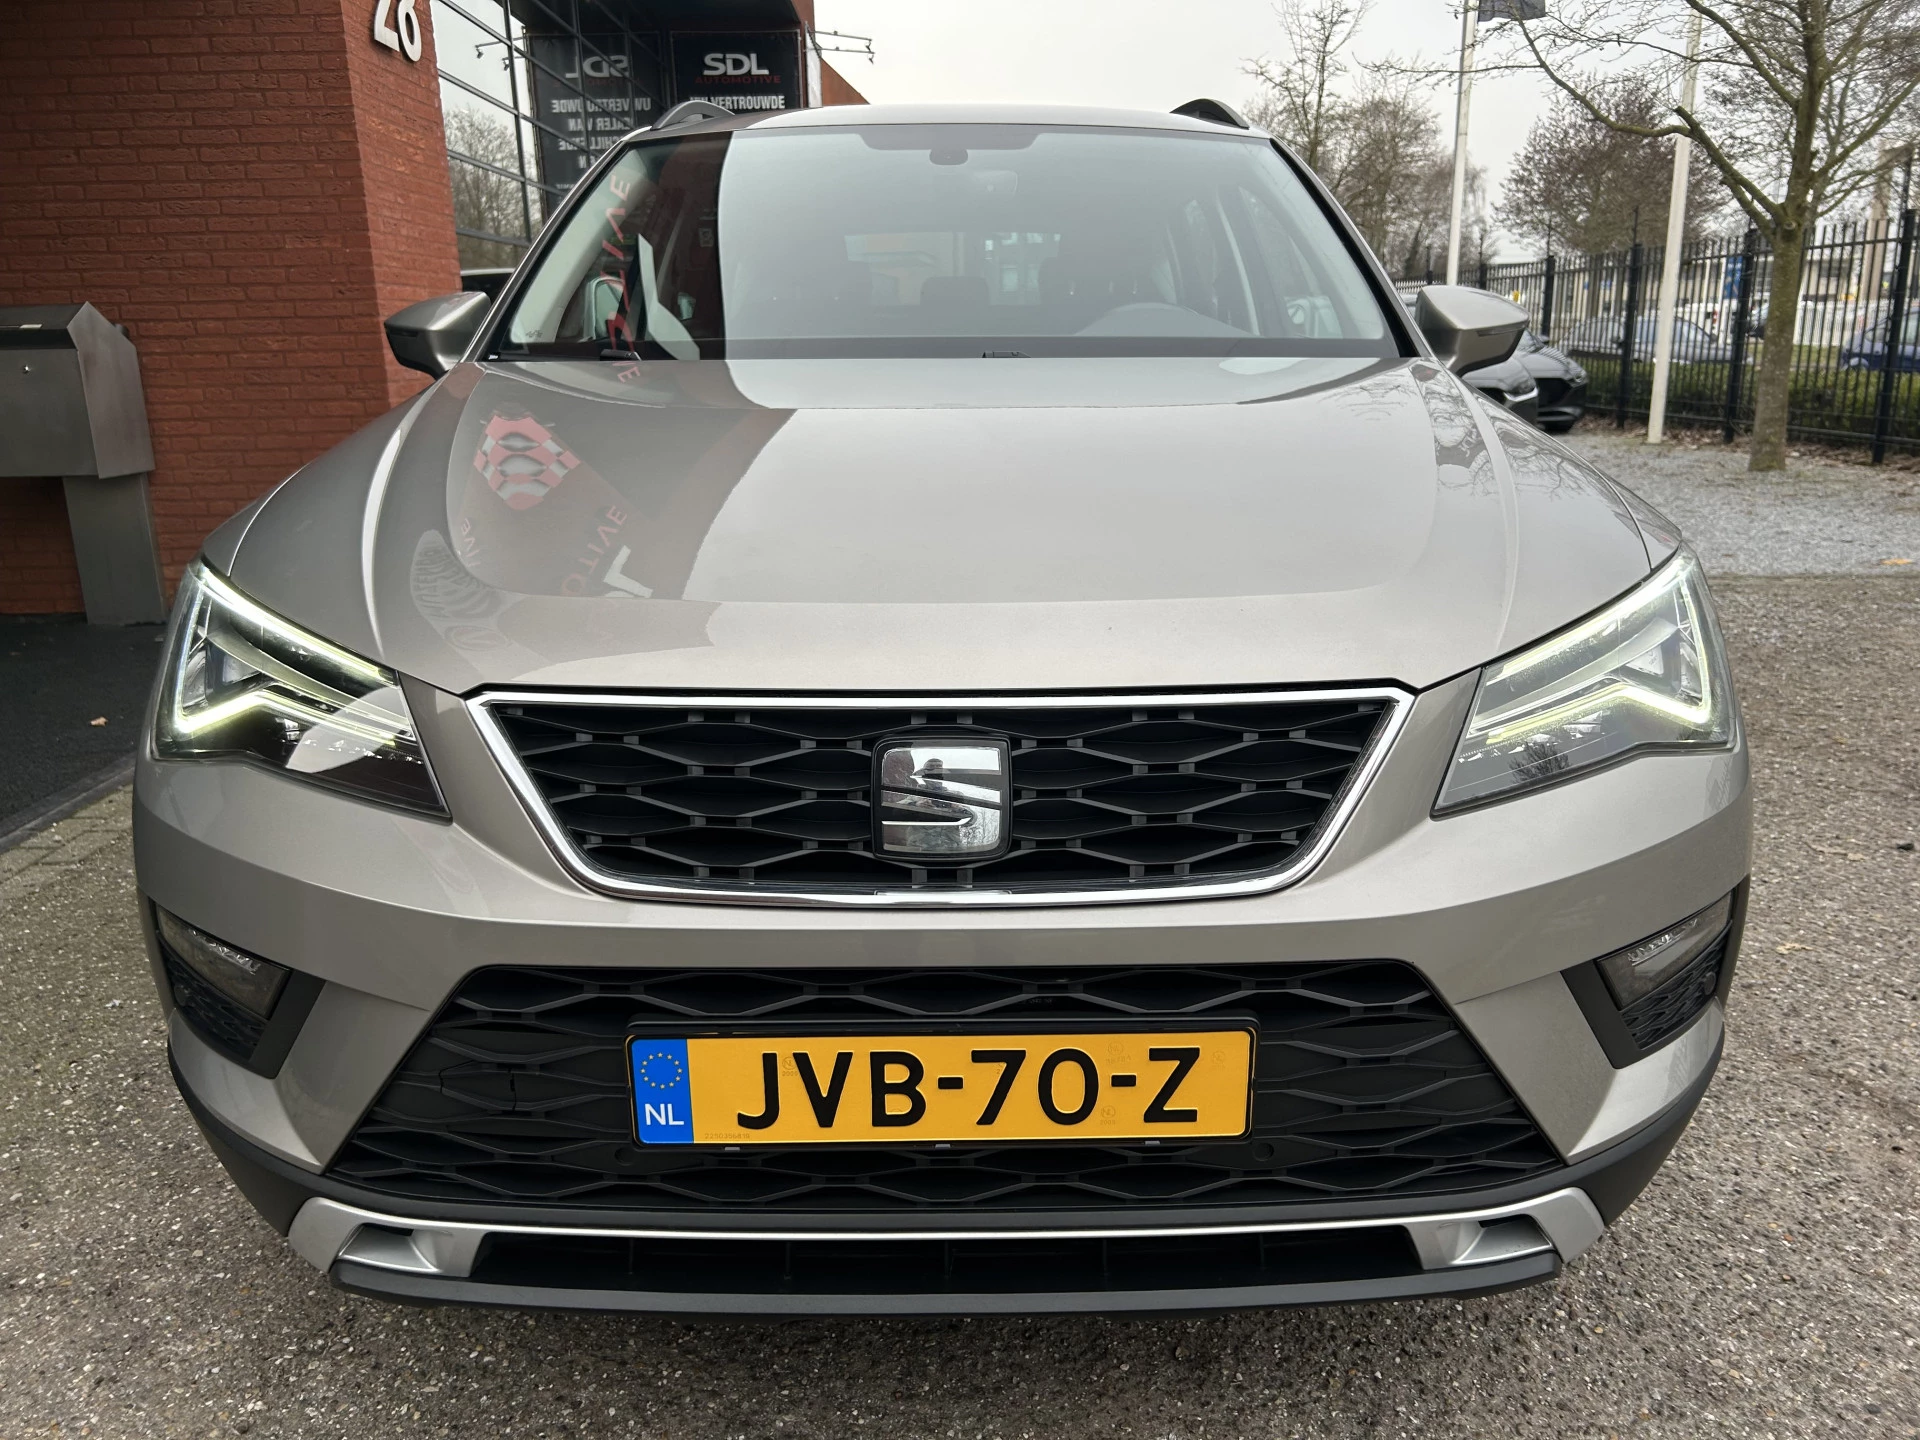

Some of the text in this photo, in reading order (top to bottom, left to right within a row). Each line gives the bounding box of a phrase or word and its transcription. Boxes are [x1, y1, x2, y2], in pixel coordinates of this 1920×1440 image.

[703, 53, 769, 75] SDL
[695, 75, 782, 84] AUTOMOTIVE
[737, 1046, 1200, 1130] JVB-70-Z
[645, 1103, 685, 1126] NL
